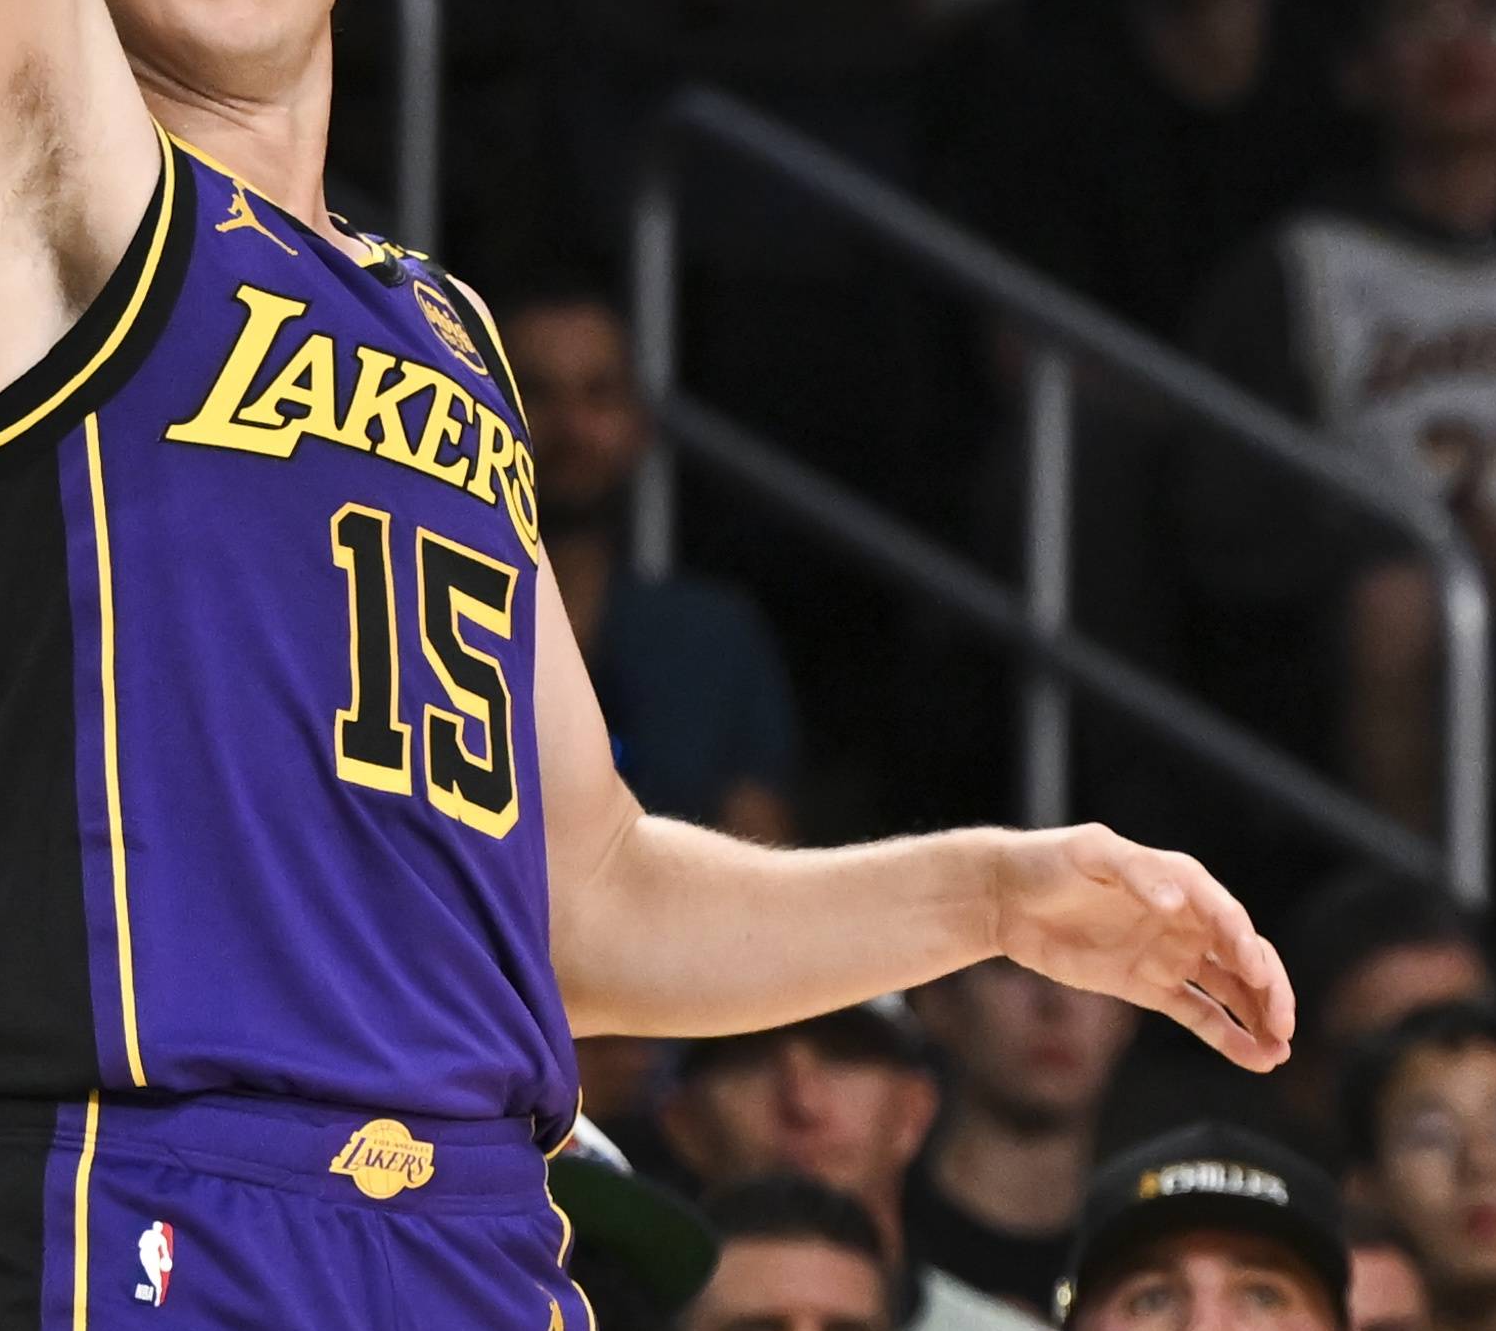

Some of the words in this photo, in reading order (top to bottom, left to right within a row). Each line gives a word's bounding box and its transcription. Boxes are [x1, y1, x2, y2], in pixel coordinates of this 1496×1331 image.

[165, 283, 539, 567] LAKERS
[330, 502, 518, 839] 15
[342, 1137, 427, 1183] LAKERS
